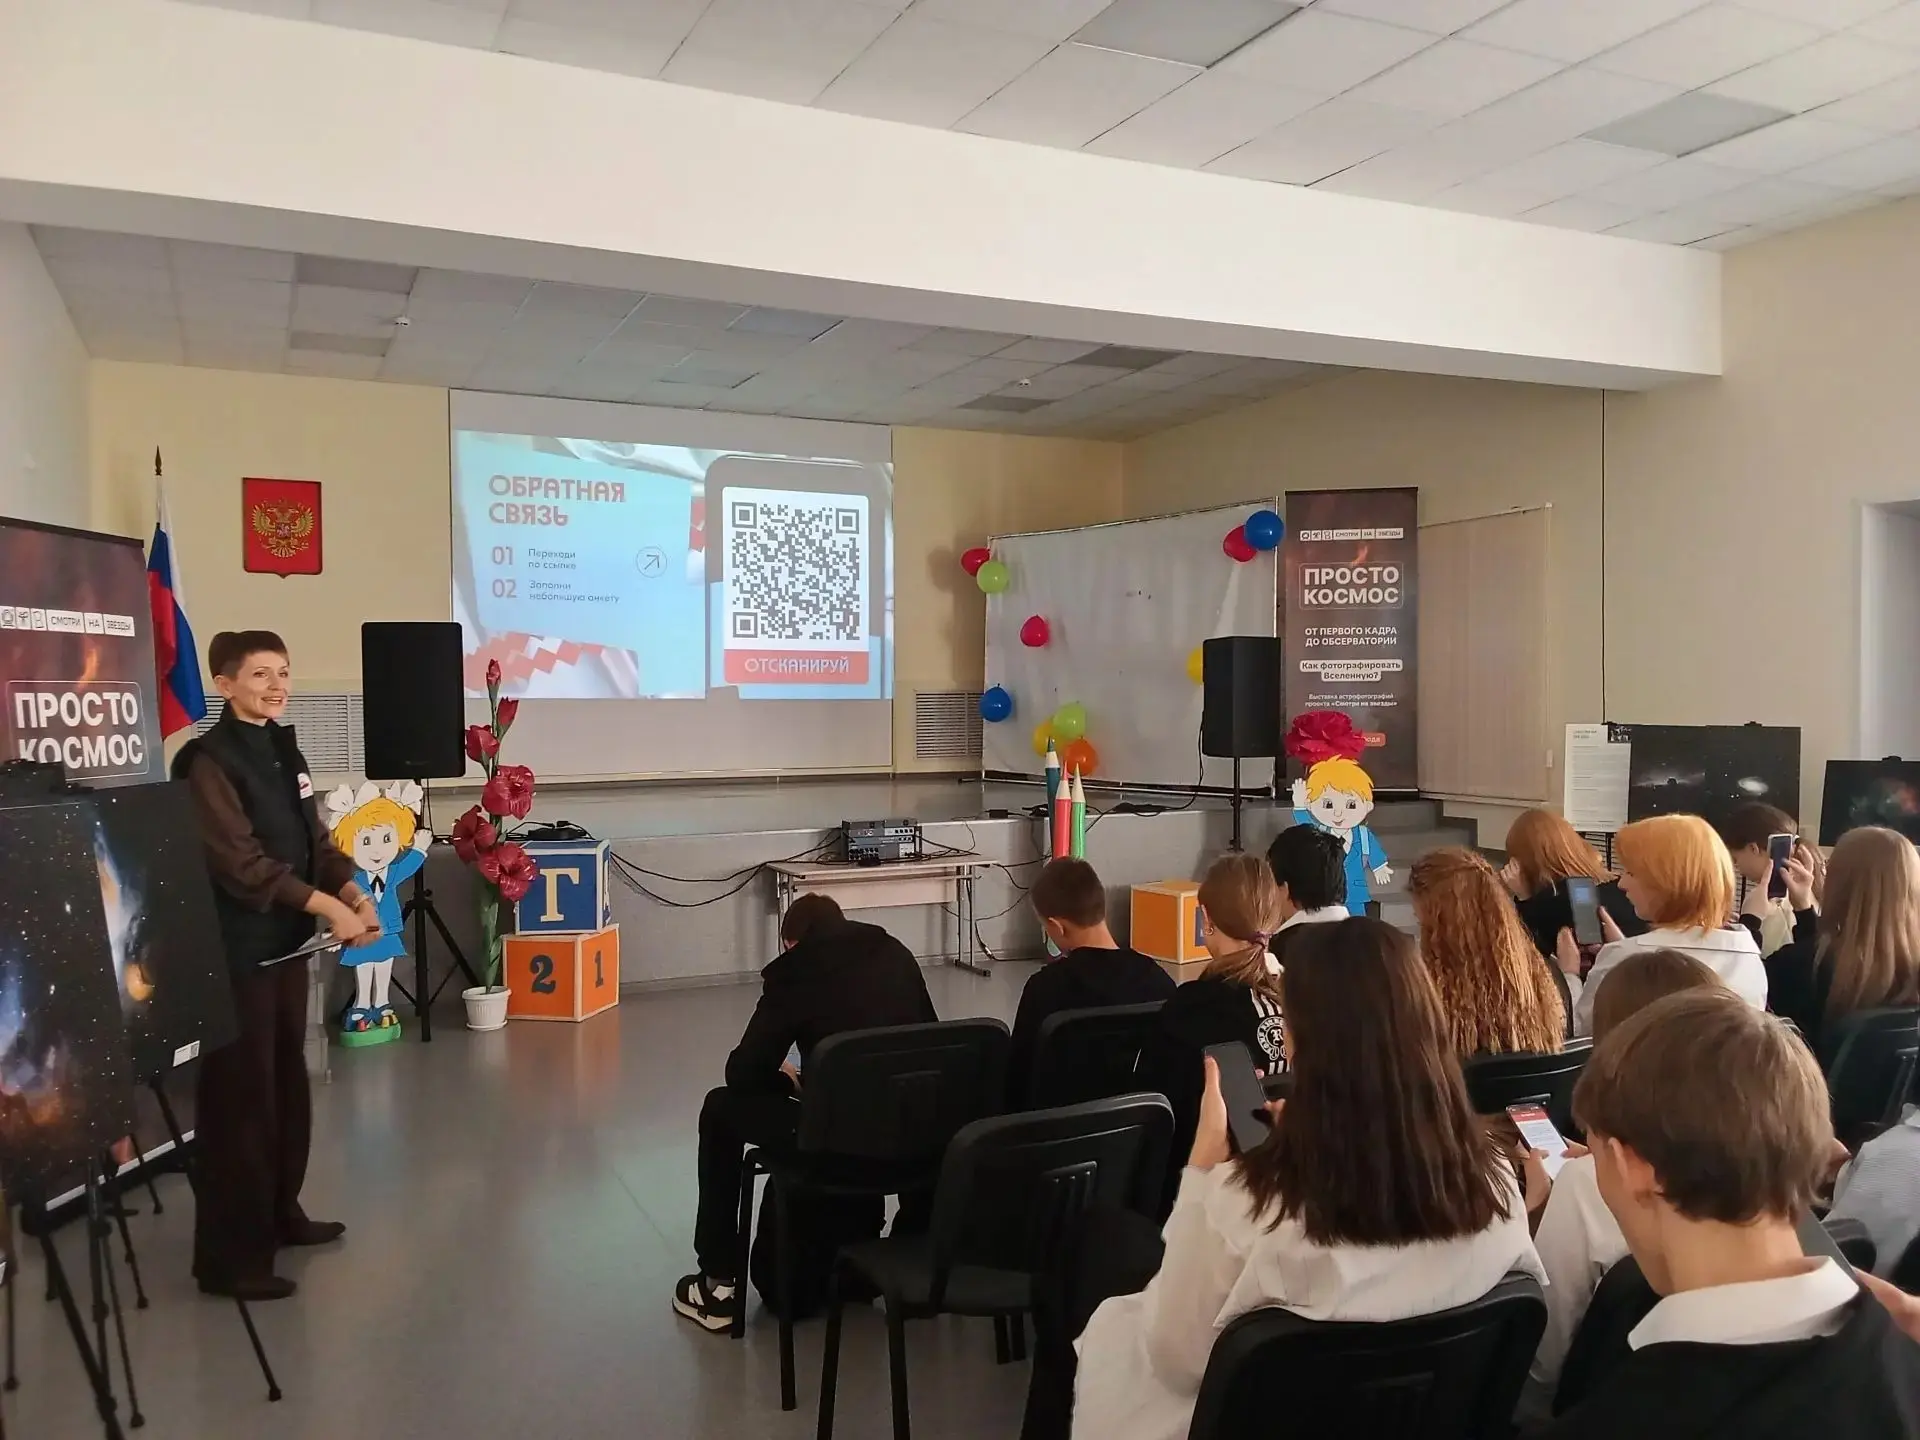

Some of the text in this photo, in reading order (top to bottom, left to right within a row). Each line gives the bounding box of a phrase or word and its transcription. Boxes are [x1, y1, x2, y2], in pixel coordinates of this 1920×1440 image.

[488, 474, 626, 502] ОБРАТНАЯ
[488, 502, 569, 526] СВЯЗЬ
[491, 546, 514, 565] 01
[528, 548, 576, 561] Переходи
[544, 561, 577, 570] ссылке
[1304, 566, 1400, 585] ПРОСТО
[491, 578, 517, 599] 02
[529, 580, 572, 591] Заполни
[1303, 587, 1399, 605] КОСМОС
[50, 616, 82, 627] СМОТРИ
[88, 620, 101, 628] НА
[1304, 626, 1398, 636] ОТ ПЕРВОГО КАДРА
[1304, 636, 1397, 647] ДО ОБСЕРВАТОРИИ
[744, 655, 850, 674] ОТСКАНИРУЙ
[1302, 661, 1401, 671] Как фотографировать
[1323, 671, 1379, 680] Вселенную?
[14, 691, 138, 728] ПРОСТО
[19, 734, 143, 769] КОСМОС
[529, 954, 556, 995] 2
[594, 950, 605, 988] 1
